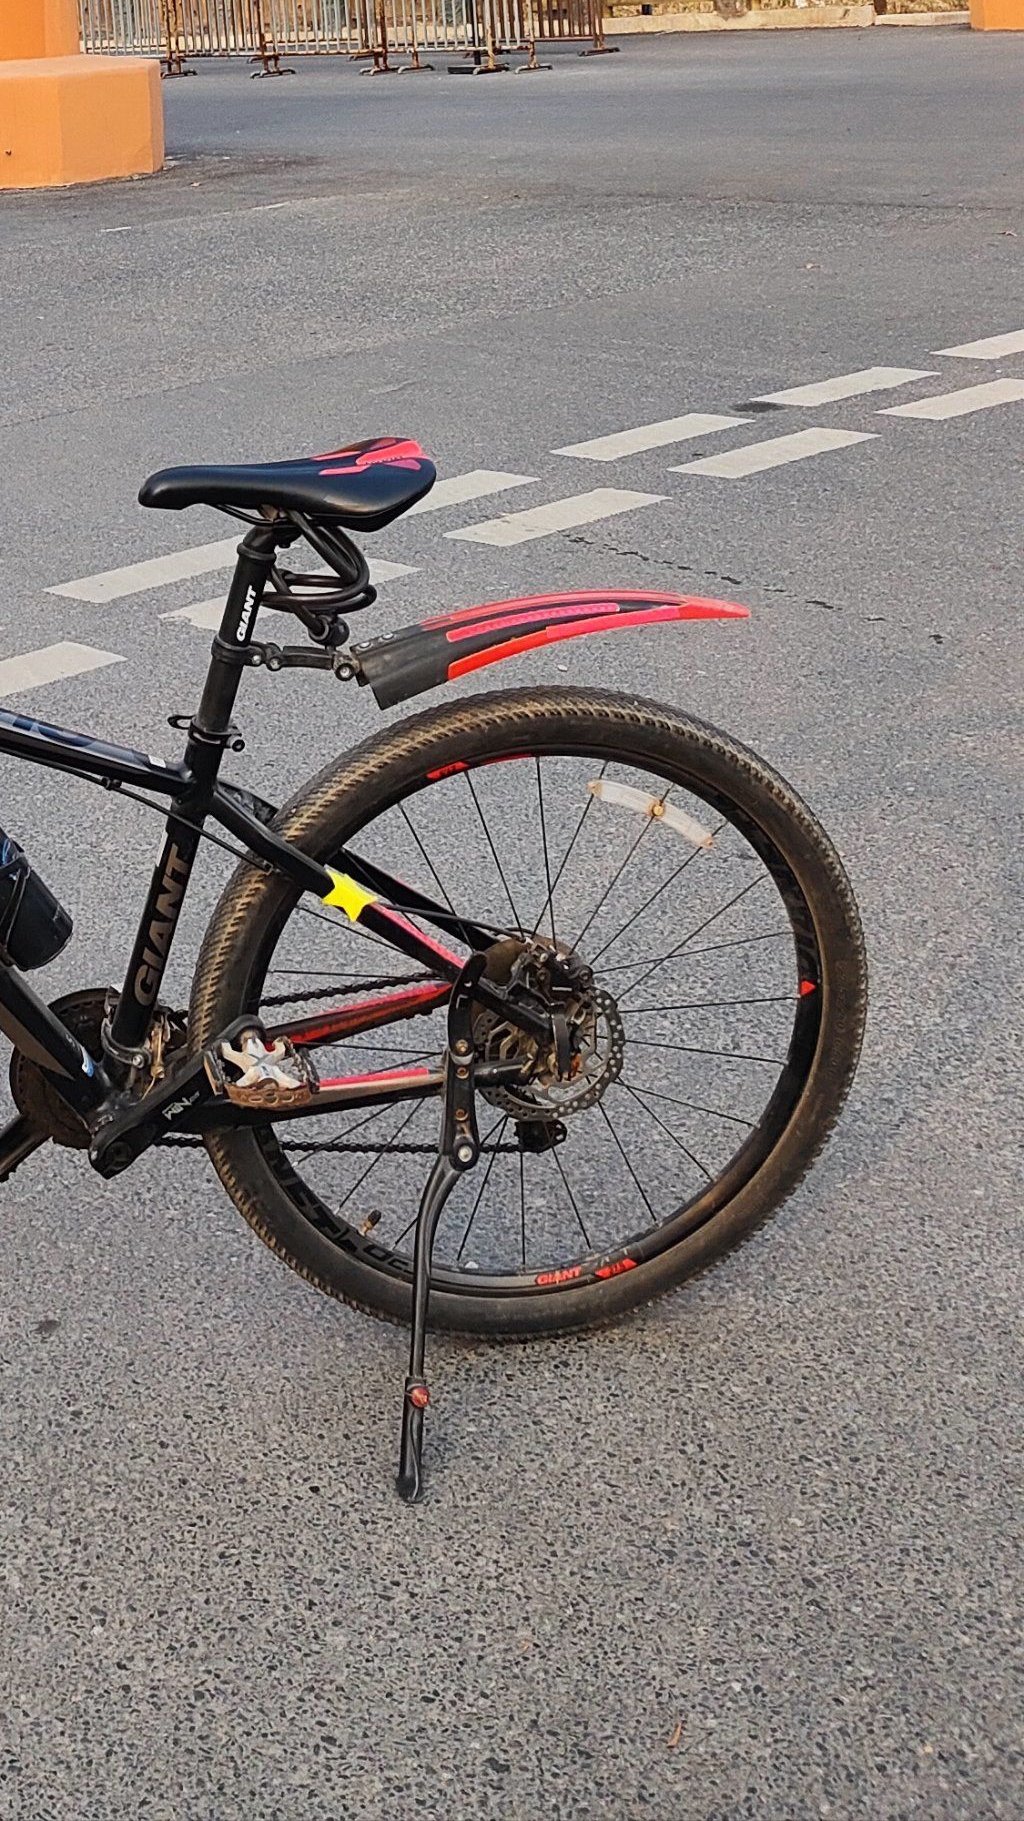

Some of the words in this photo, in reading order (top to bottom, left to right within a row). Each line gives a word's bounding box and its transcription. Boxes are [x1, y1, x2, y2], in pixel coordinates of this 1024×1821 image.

[236, 584, 256, 642] GIANT
[134, 842, 191, 1006] GIANT
[536, 1265, 582, 1285] GIANT
